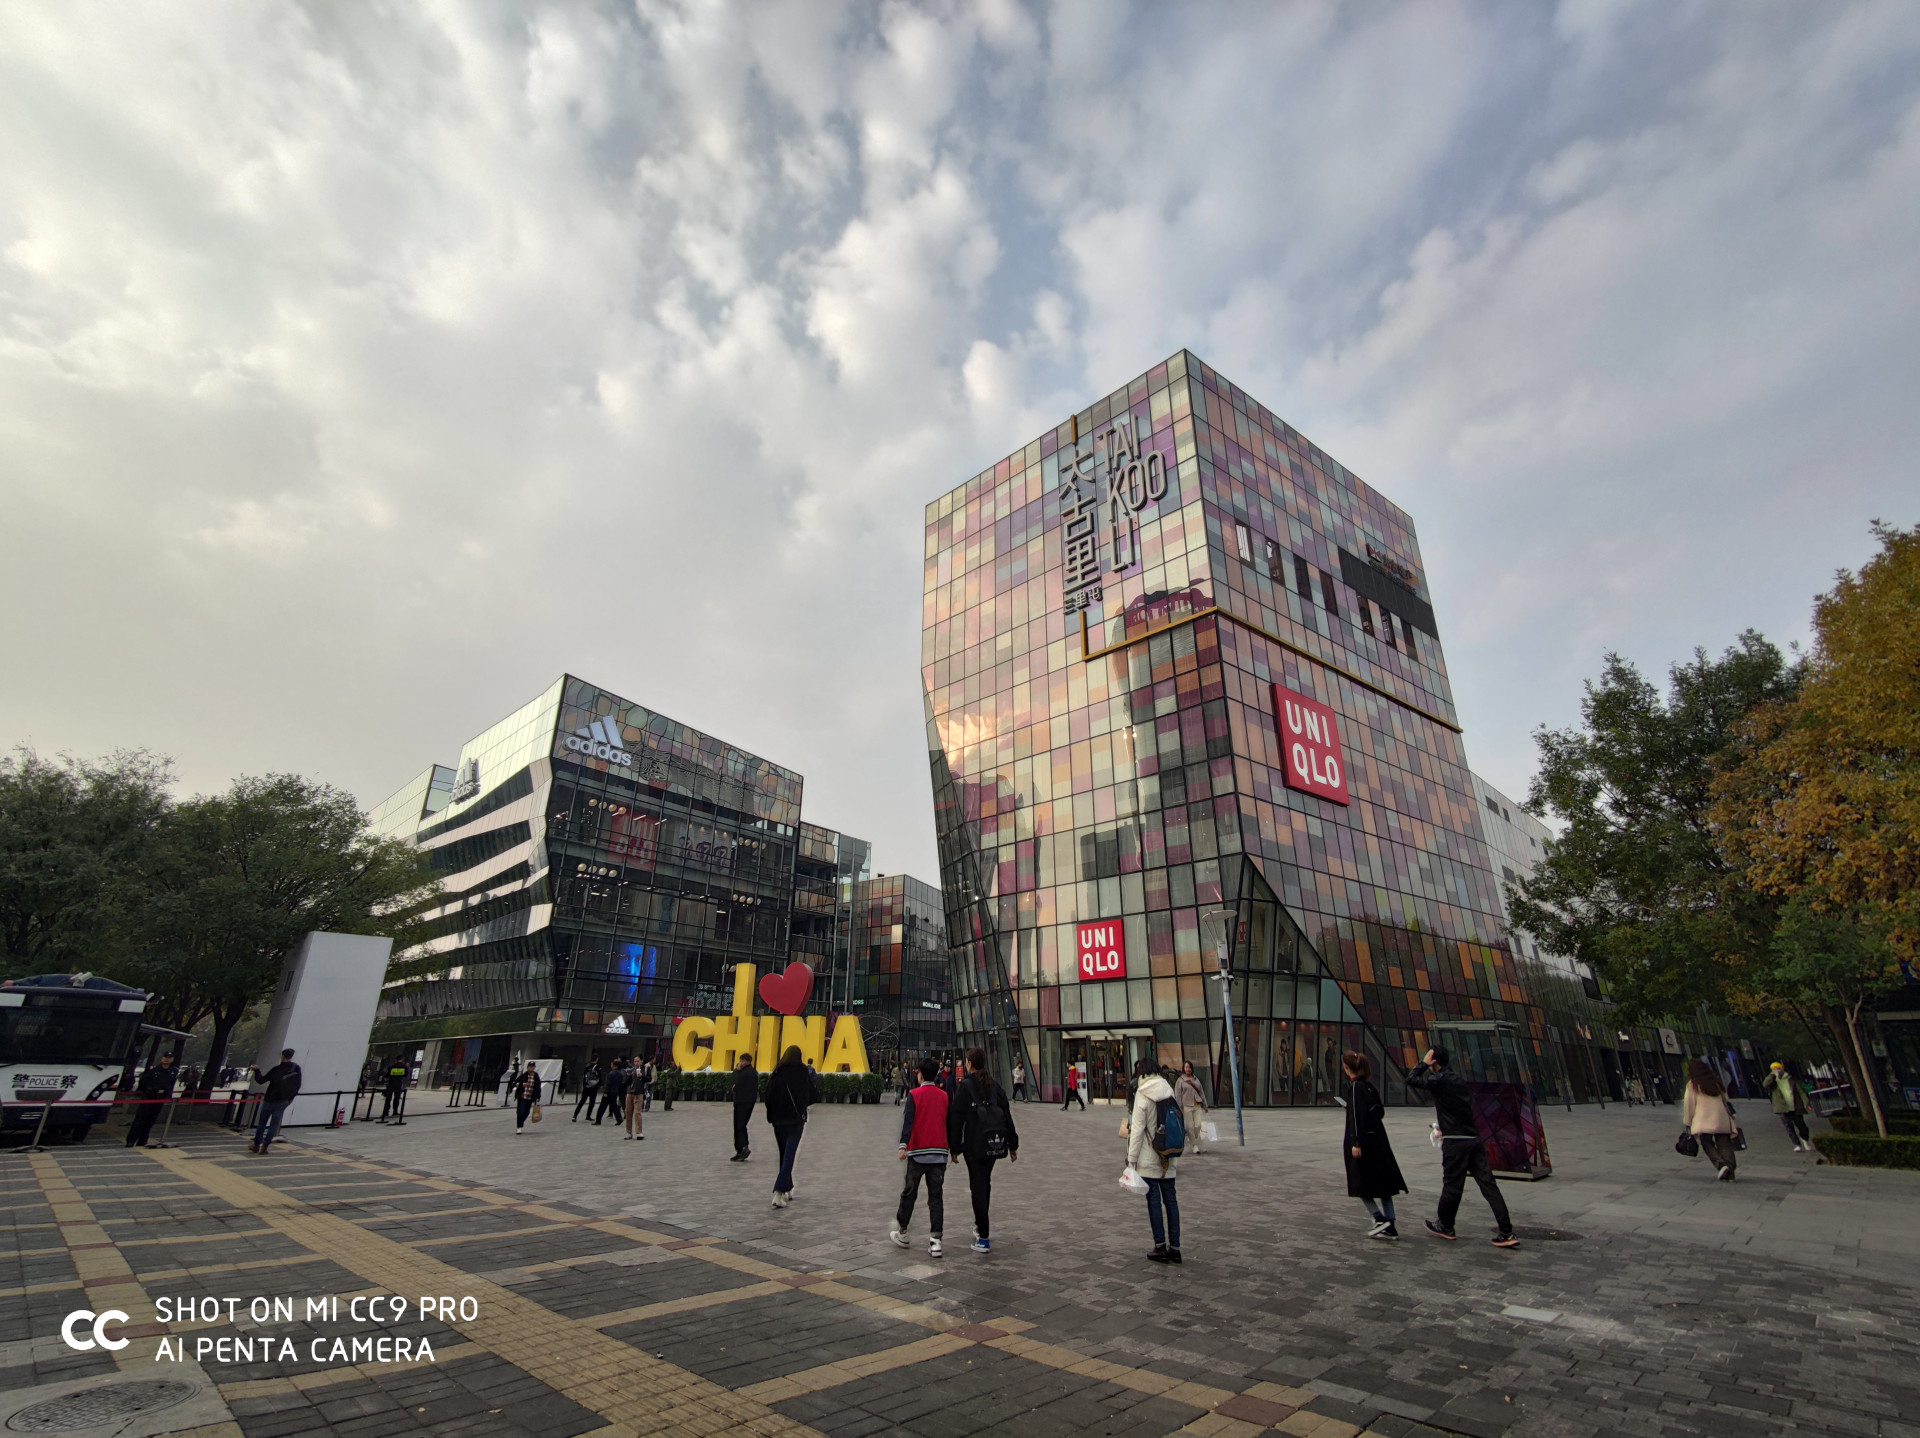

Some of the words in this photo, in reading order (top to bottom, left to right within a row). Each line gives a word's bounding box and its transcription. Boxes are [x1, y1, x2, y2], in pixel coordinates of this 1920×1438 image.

[1097, 413, 1141, 474] TAI
[1106, 450, 1168, 523] KOO
[1059, 448, 1102, 595] 太古里
[1110, 516, 1136, 572] LI
[1285, 699, 1331, 748] UNI
[564, 735, 632, 767] adidas
[1292, 742, 1340, 789] QLO
[1081, 926, 1114, 949] UNI
[1082, 950, 1119, 976] QLO
[732, 963, 757, 1016] I
[604, 1026, 629, 1035] adidas
[672, 1015, 870, 1073] CHINA
[12, 1073, 30, 1088] 警
[28, 1078, 59, 1086] POLICE
[60, 1075, 78, 1089] 察
